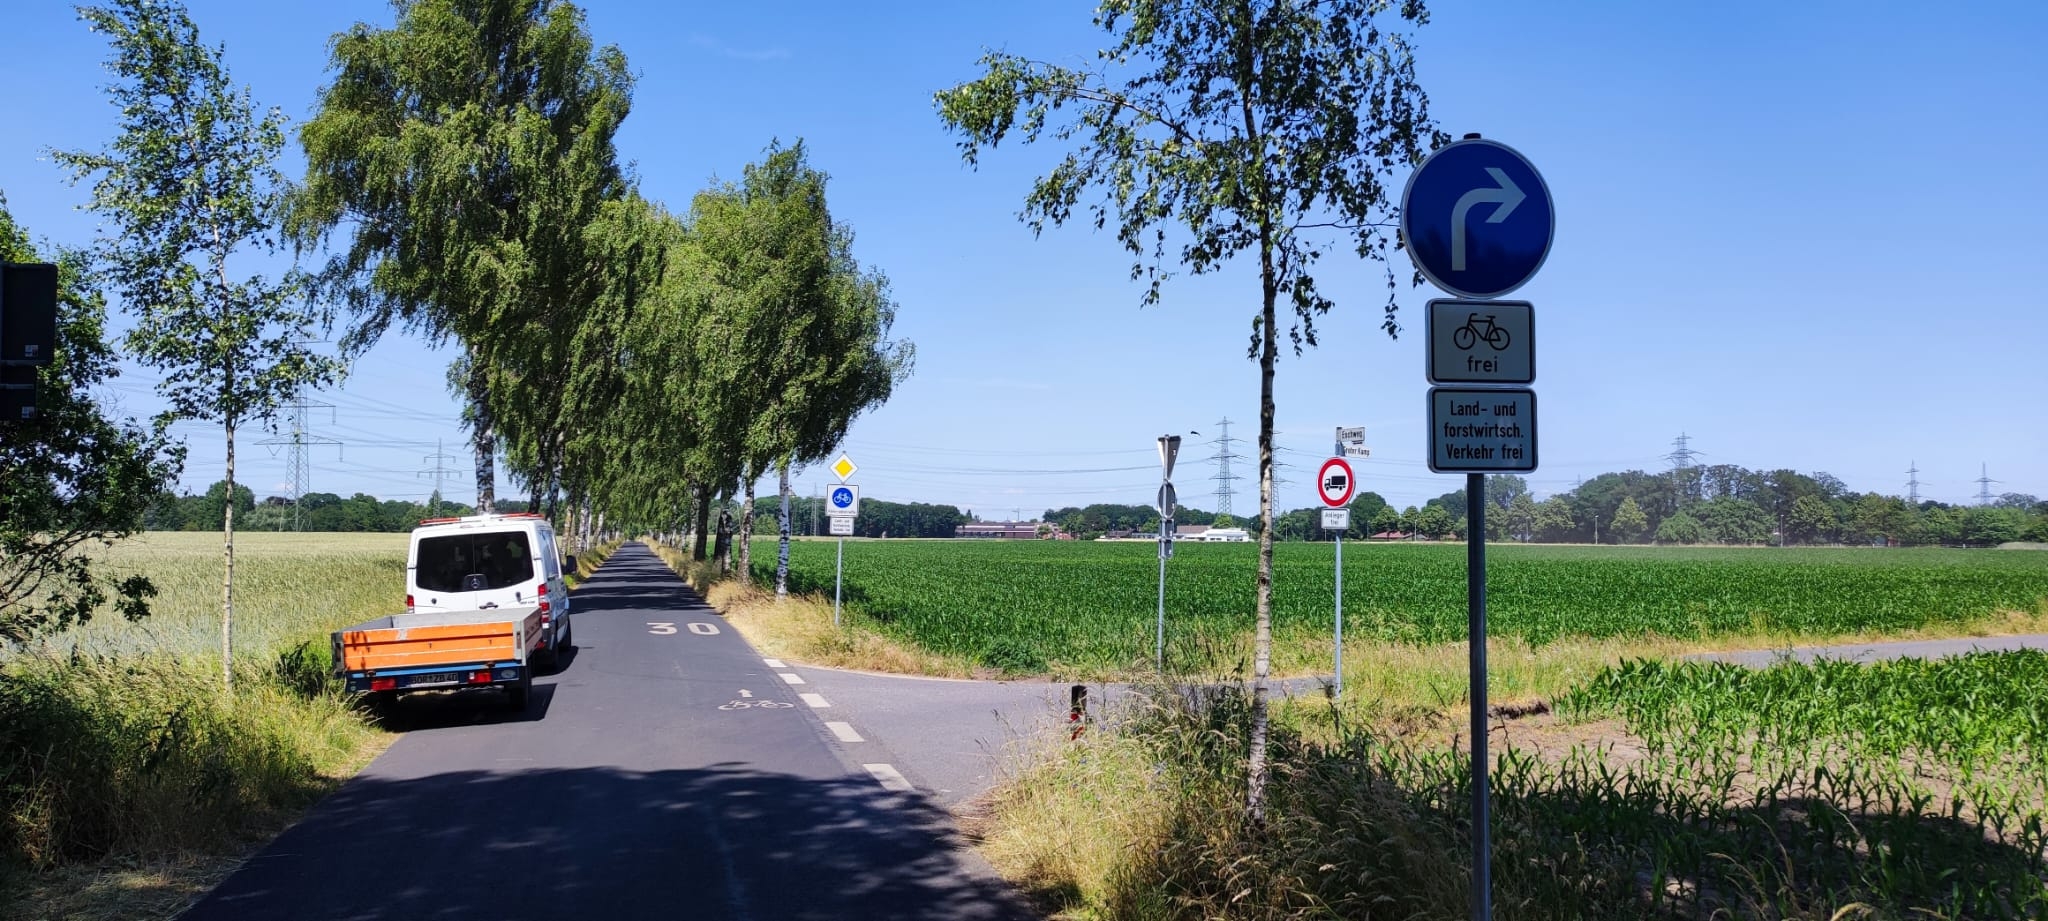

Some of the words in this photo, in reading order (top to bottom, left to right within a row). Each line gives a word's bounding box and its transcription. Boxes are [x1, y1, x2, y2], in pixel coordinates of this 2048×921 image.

[1467, 355, 1498, 373] frei
[1450, 400, 1487, 417] Land-
[1494, 401, 1517, 417] und
[1444, 422, 1524, 439] forstwirtsch.
[1446, 444, 1494, 460] Verkehr
[1501, 444, 1523, 460] frei
[646, 622, 721, 635] 30
